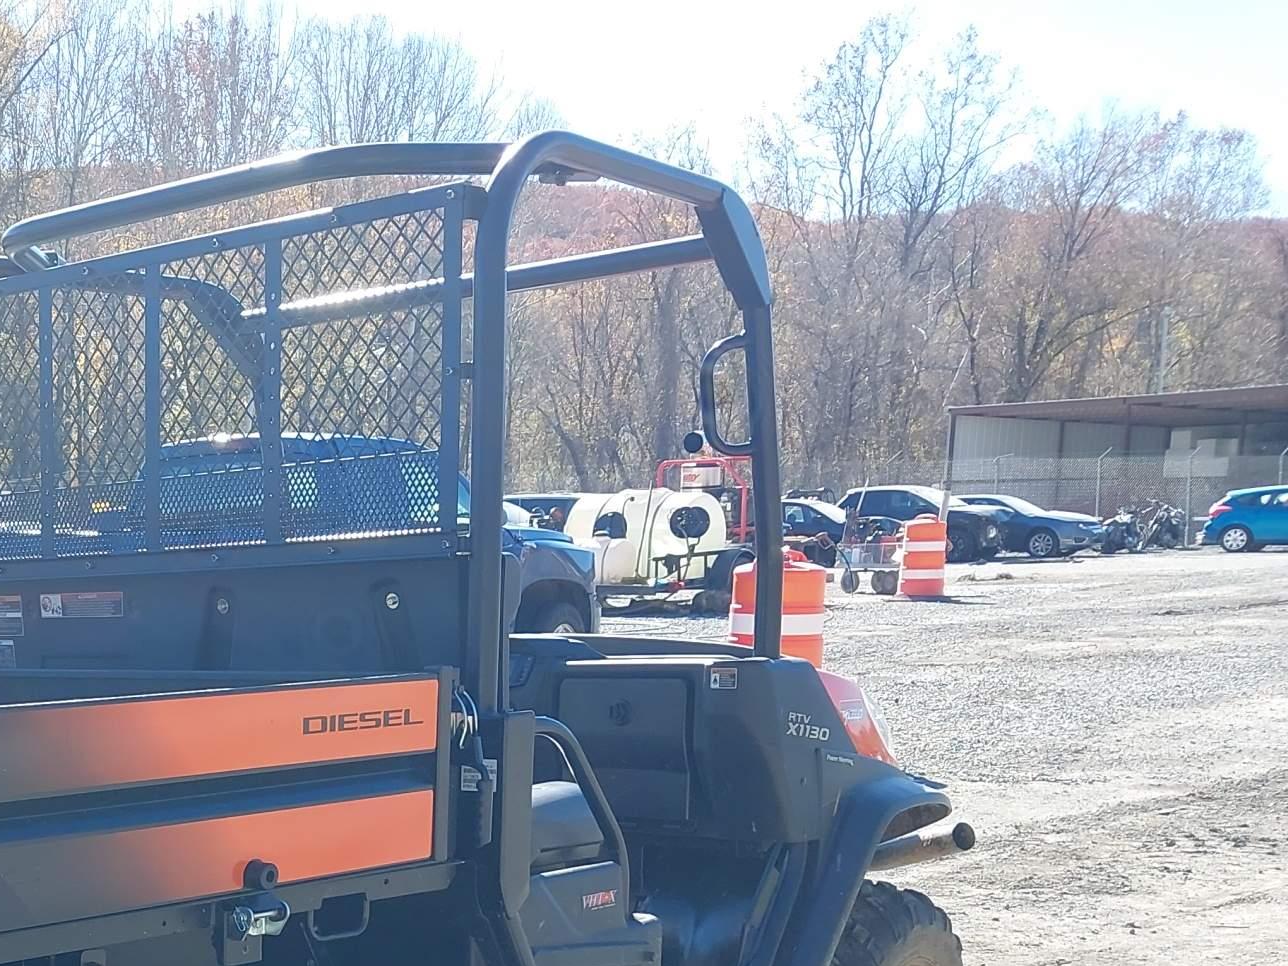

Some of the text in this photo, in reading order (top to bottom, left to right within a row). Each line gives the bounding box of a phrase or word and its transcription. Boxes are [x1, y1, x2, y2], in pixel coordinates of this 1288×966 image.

[302, 708, 424, 735] DIESEL
[787, 711, 812, 724] RTV
[785, 722, 830, 741] X1130
